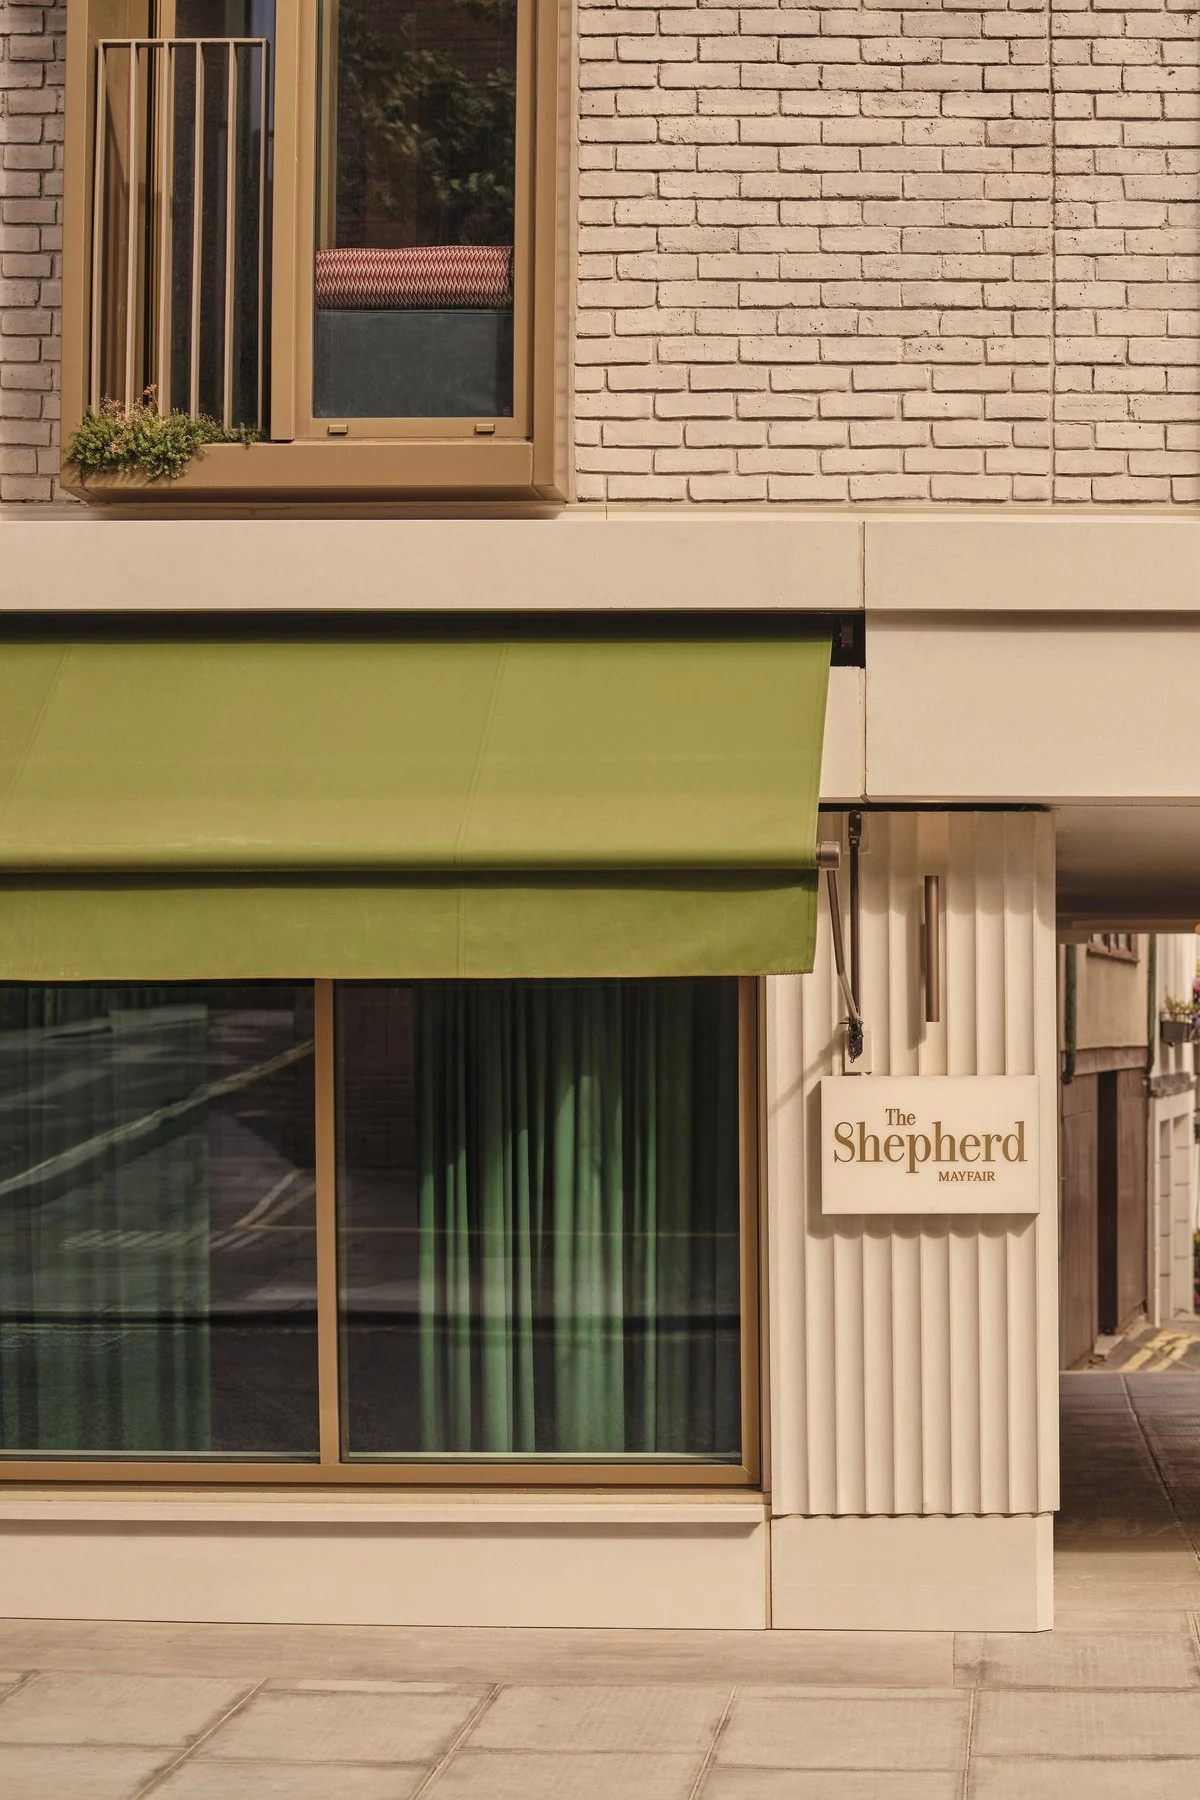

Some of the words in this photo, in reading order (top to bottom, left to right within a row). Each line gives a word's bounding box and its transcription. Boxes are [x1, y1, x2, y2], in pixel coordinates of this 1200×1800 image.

[885, 1108, 916, 1126] The
[833, 1120, 1028, 1174] Shepherd
[938, 1171, 995, 1182] MAYFAIR
